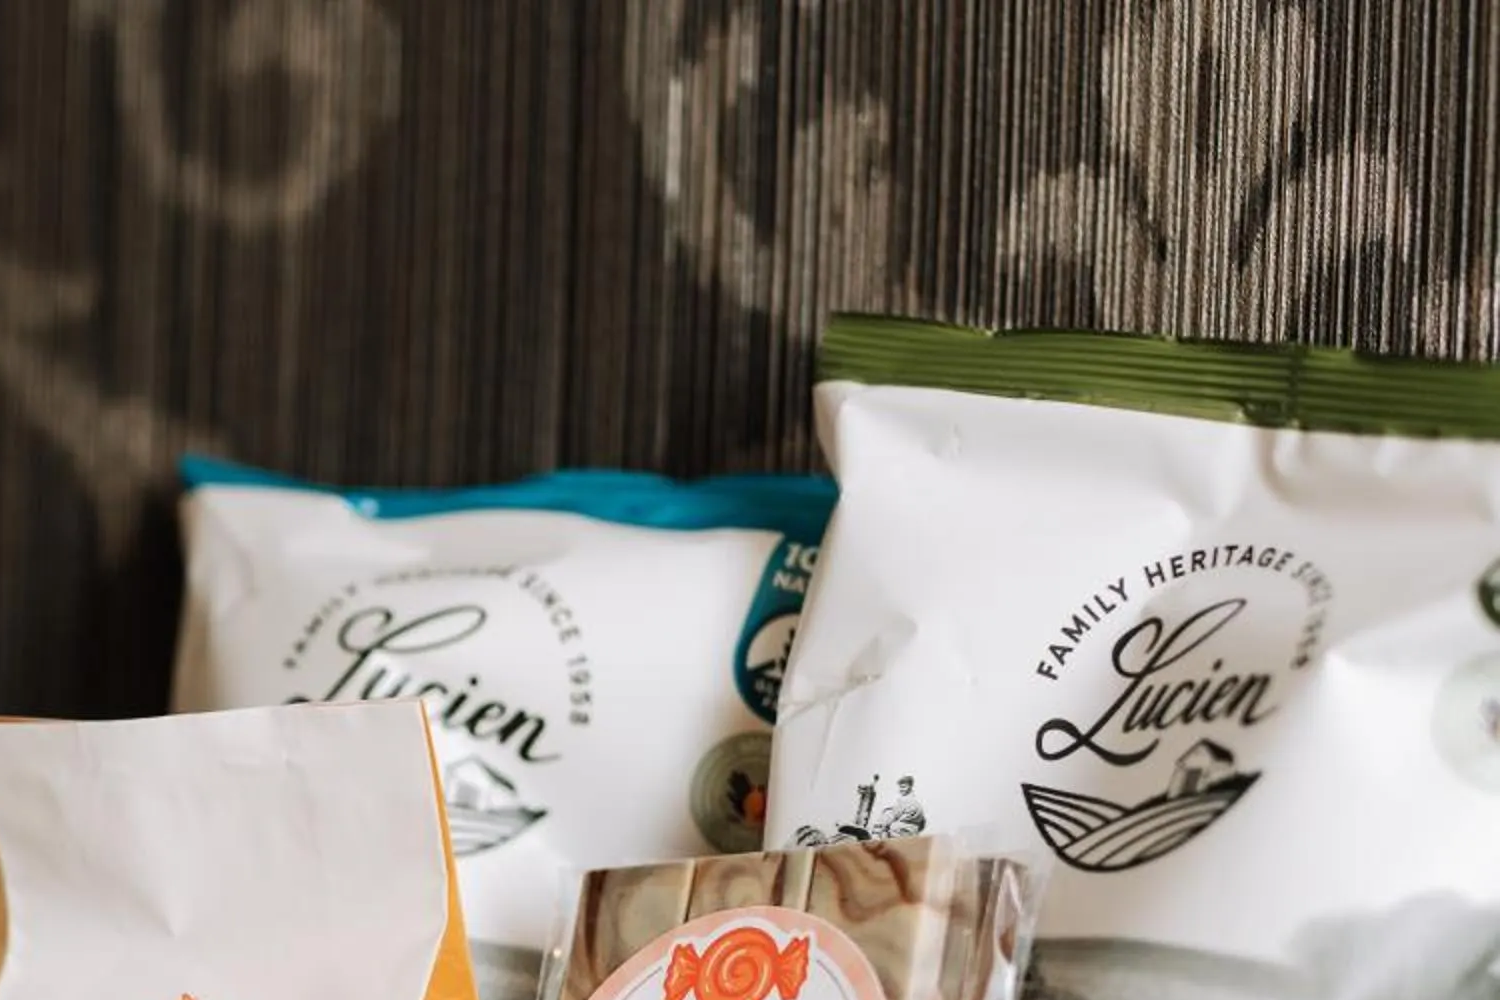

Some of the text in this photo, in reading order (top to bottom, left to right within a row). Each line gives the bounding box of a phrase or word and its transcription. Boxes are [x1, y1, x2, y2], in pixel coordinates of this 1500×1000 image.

[518, 571, 582, 645] SINCE
[1035, 576, 1129, 681] FAMILY
[1143, 544, 1295, 589] HERITAGE
[1034, 597, 1278, 767] Lucien
